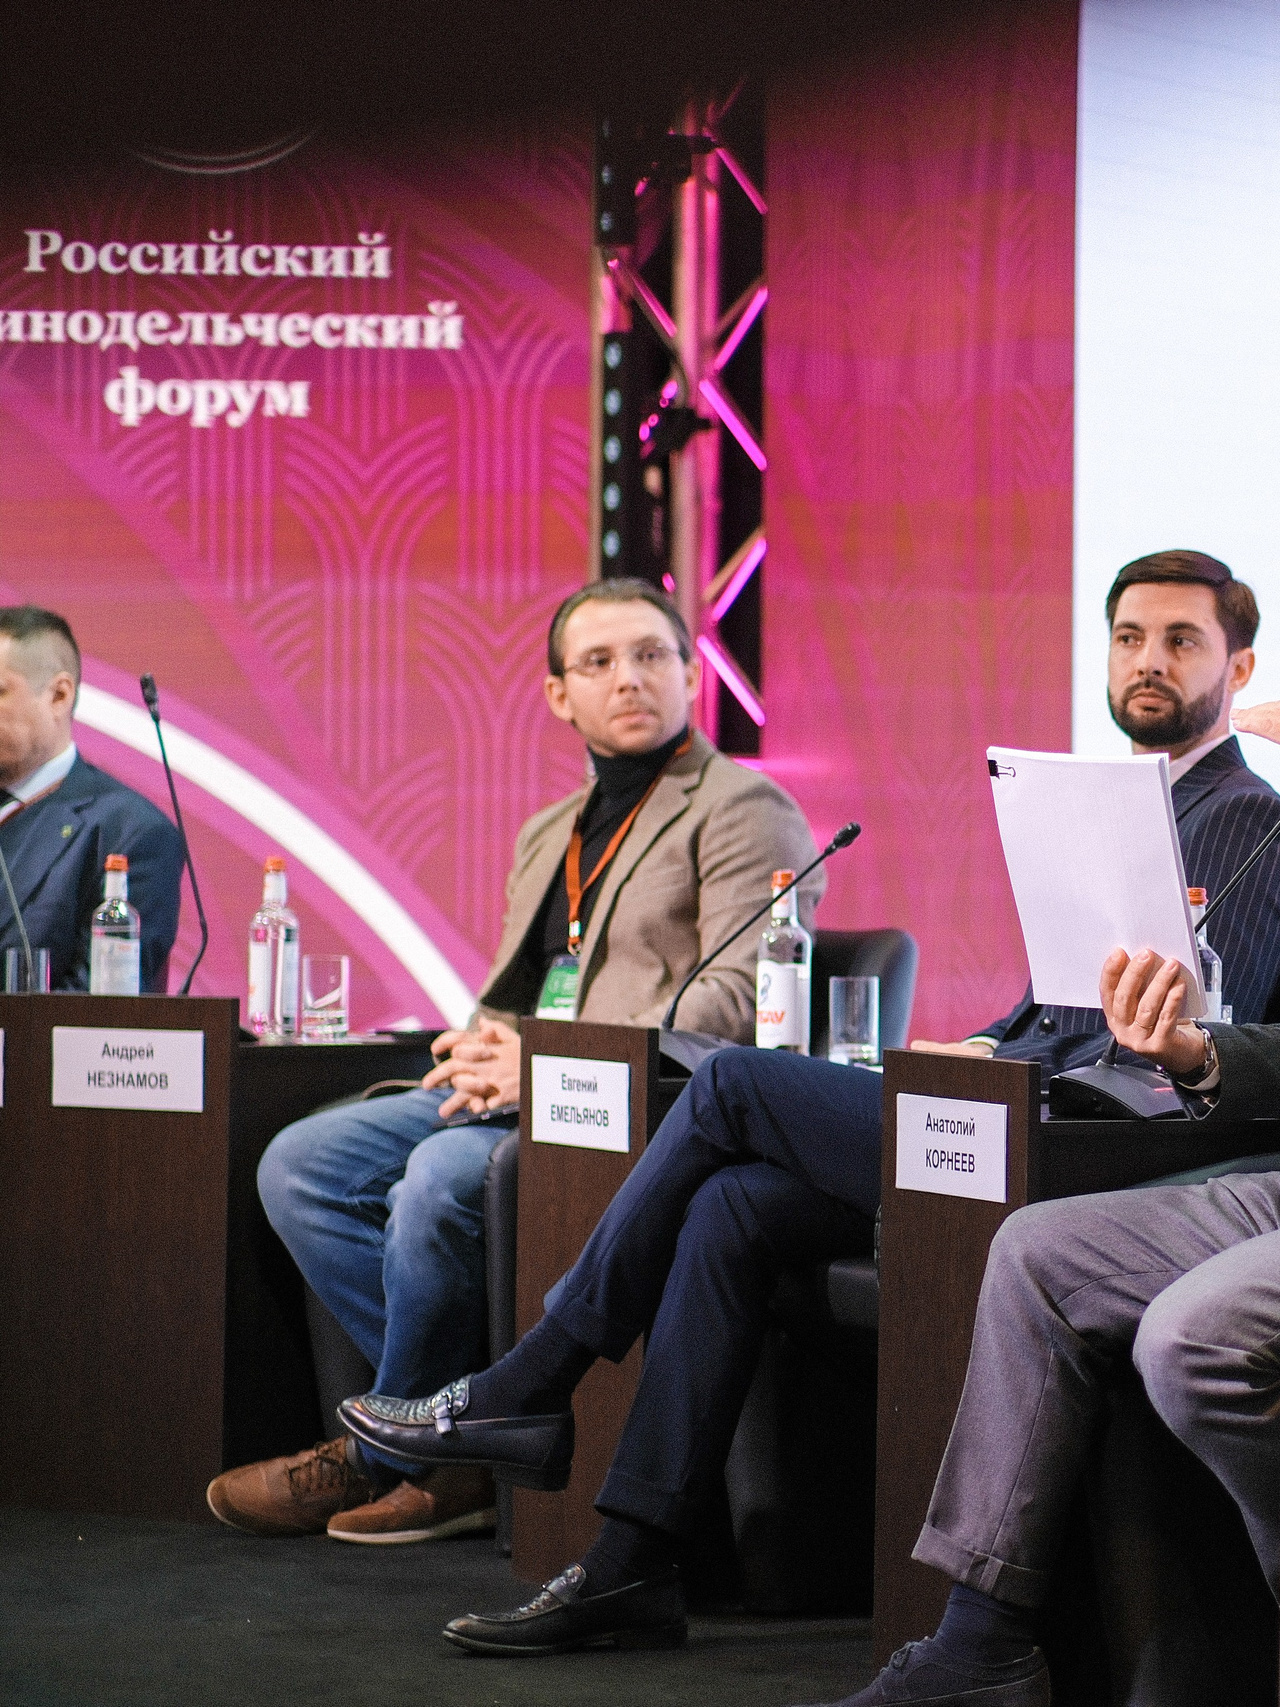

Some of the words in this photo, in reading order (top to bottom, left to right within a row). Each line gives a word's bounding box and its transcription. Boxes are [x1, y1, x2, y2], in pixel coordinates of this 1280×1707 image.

[24, 229, 393, 279] Российский
[103, 366, 311, 428] форум
[101, 1042, 155, 1062] Андрей
[86, 1071, 170, 1091] НЕЗНАМОВ
[560, 1073, 599, 1094] Евгений
[550, 1104, 610, 1128] ЕМЕЛЬЯНОВ
[925, 1112, 976, 1137] Анатолий
[925, 1148, 976, 1173] КОРНЕЕВ
